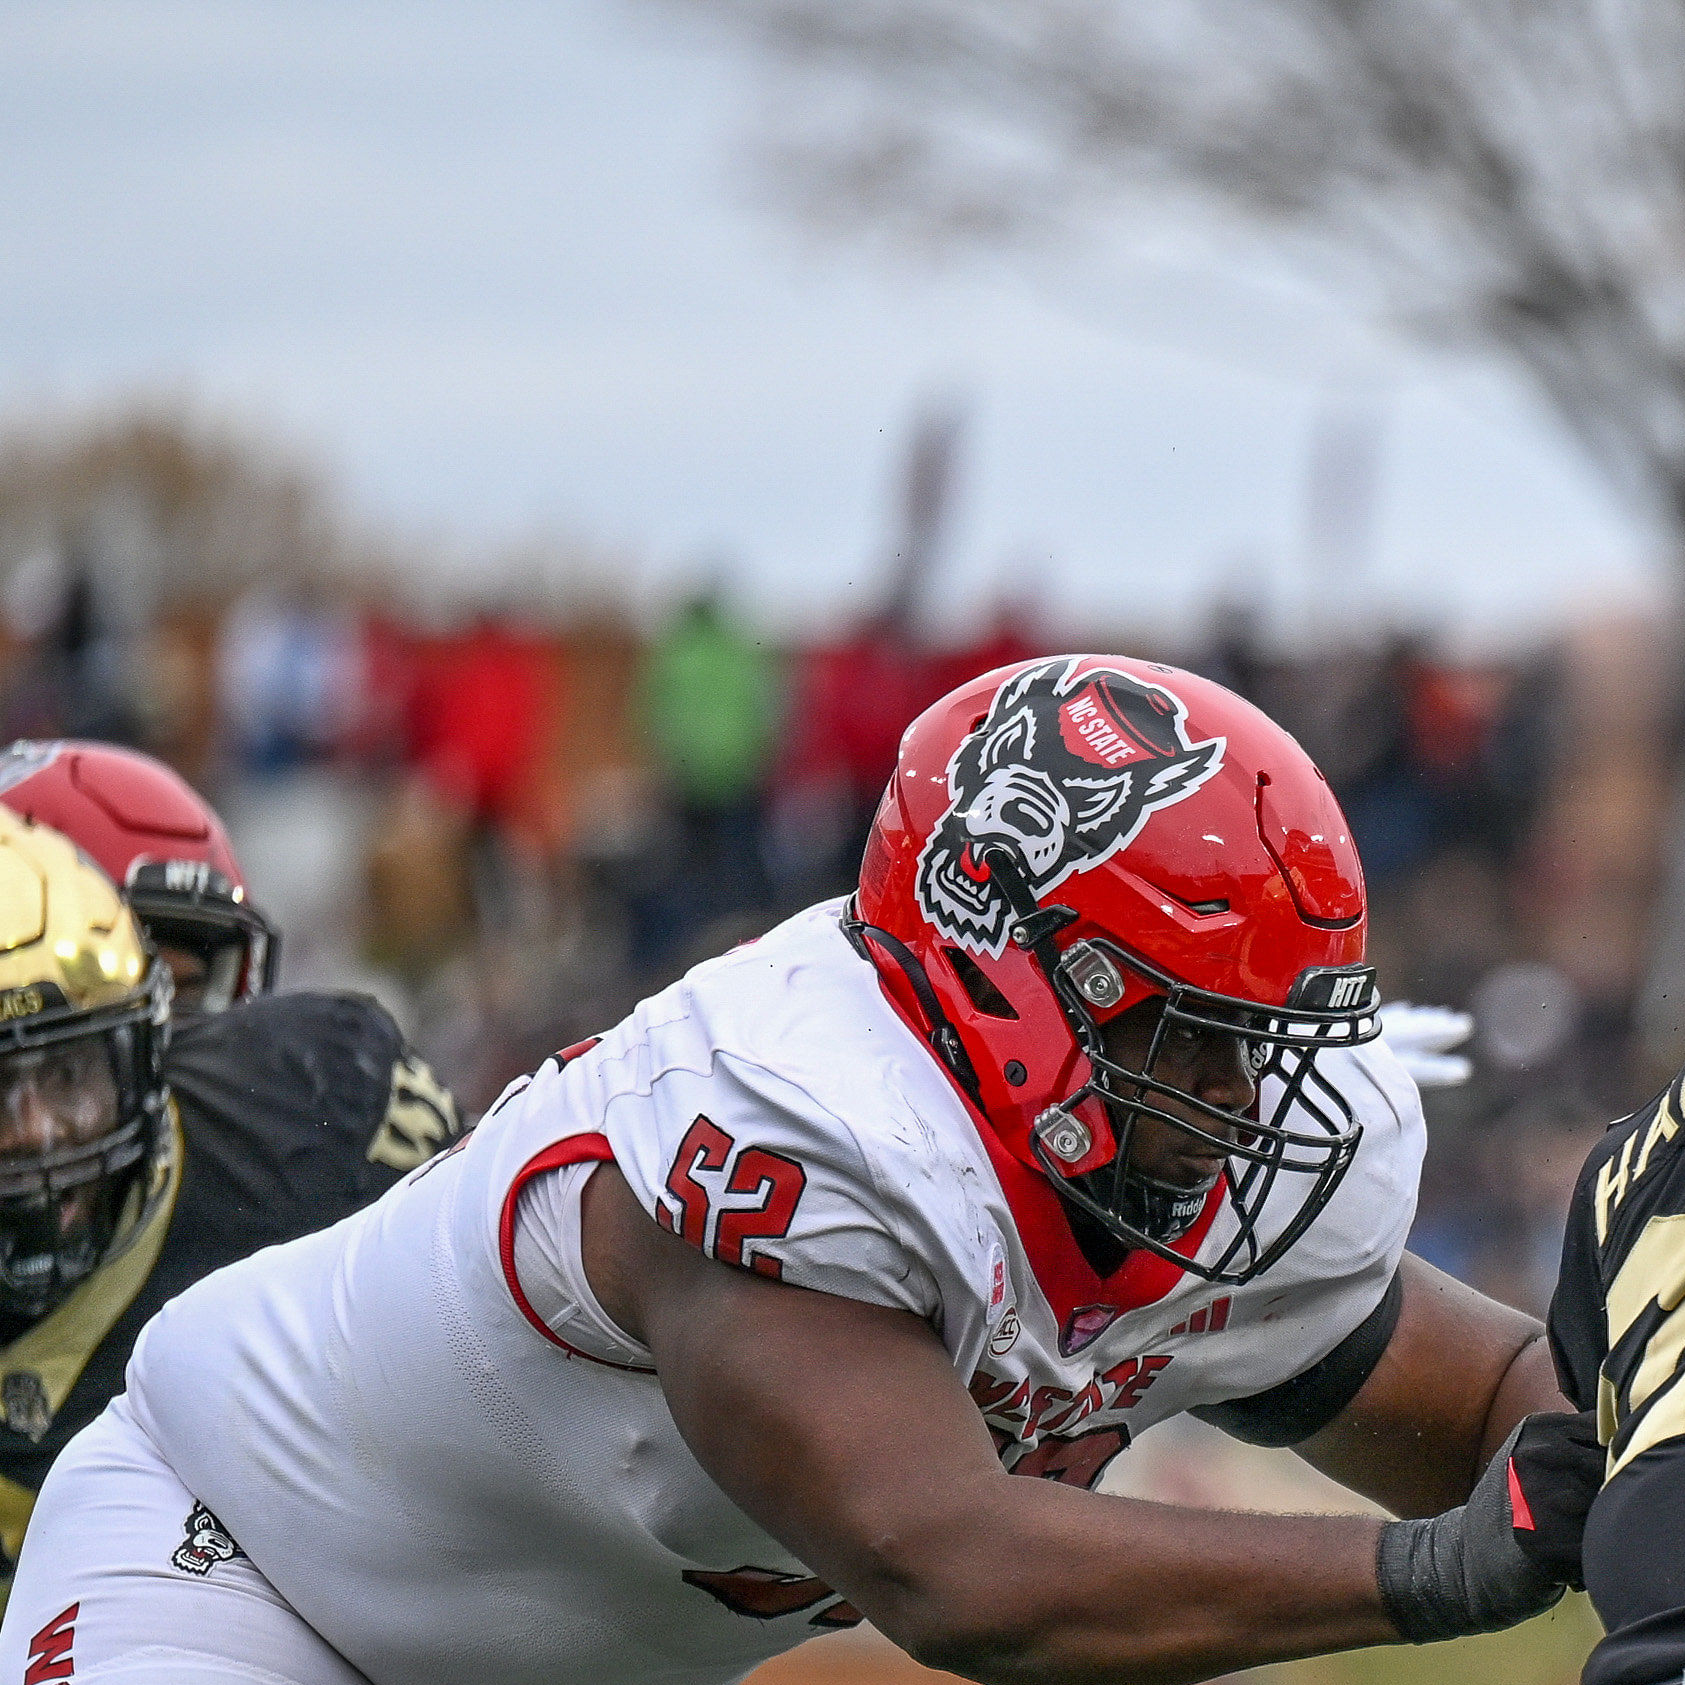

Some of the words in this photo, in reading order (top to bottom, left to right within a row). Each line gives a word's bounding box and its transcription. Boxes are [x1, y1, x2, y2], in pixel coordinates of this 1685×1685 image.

[1066, 696, 1097, 722] NC
[1079, 718, 1136, 764] STATE
[1327, 975, 1368, 1009] HTT
[656, 1113, 807, 1281] 52
